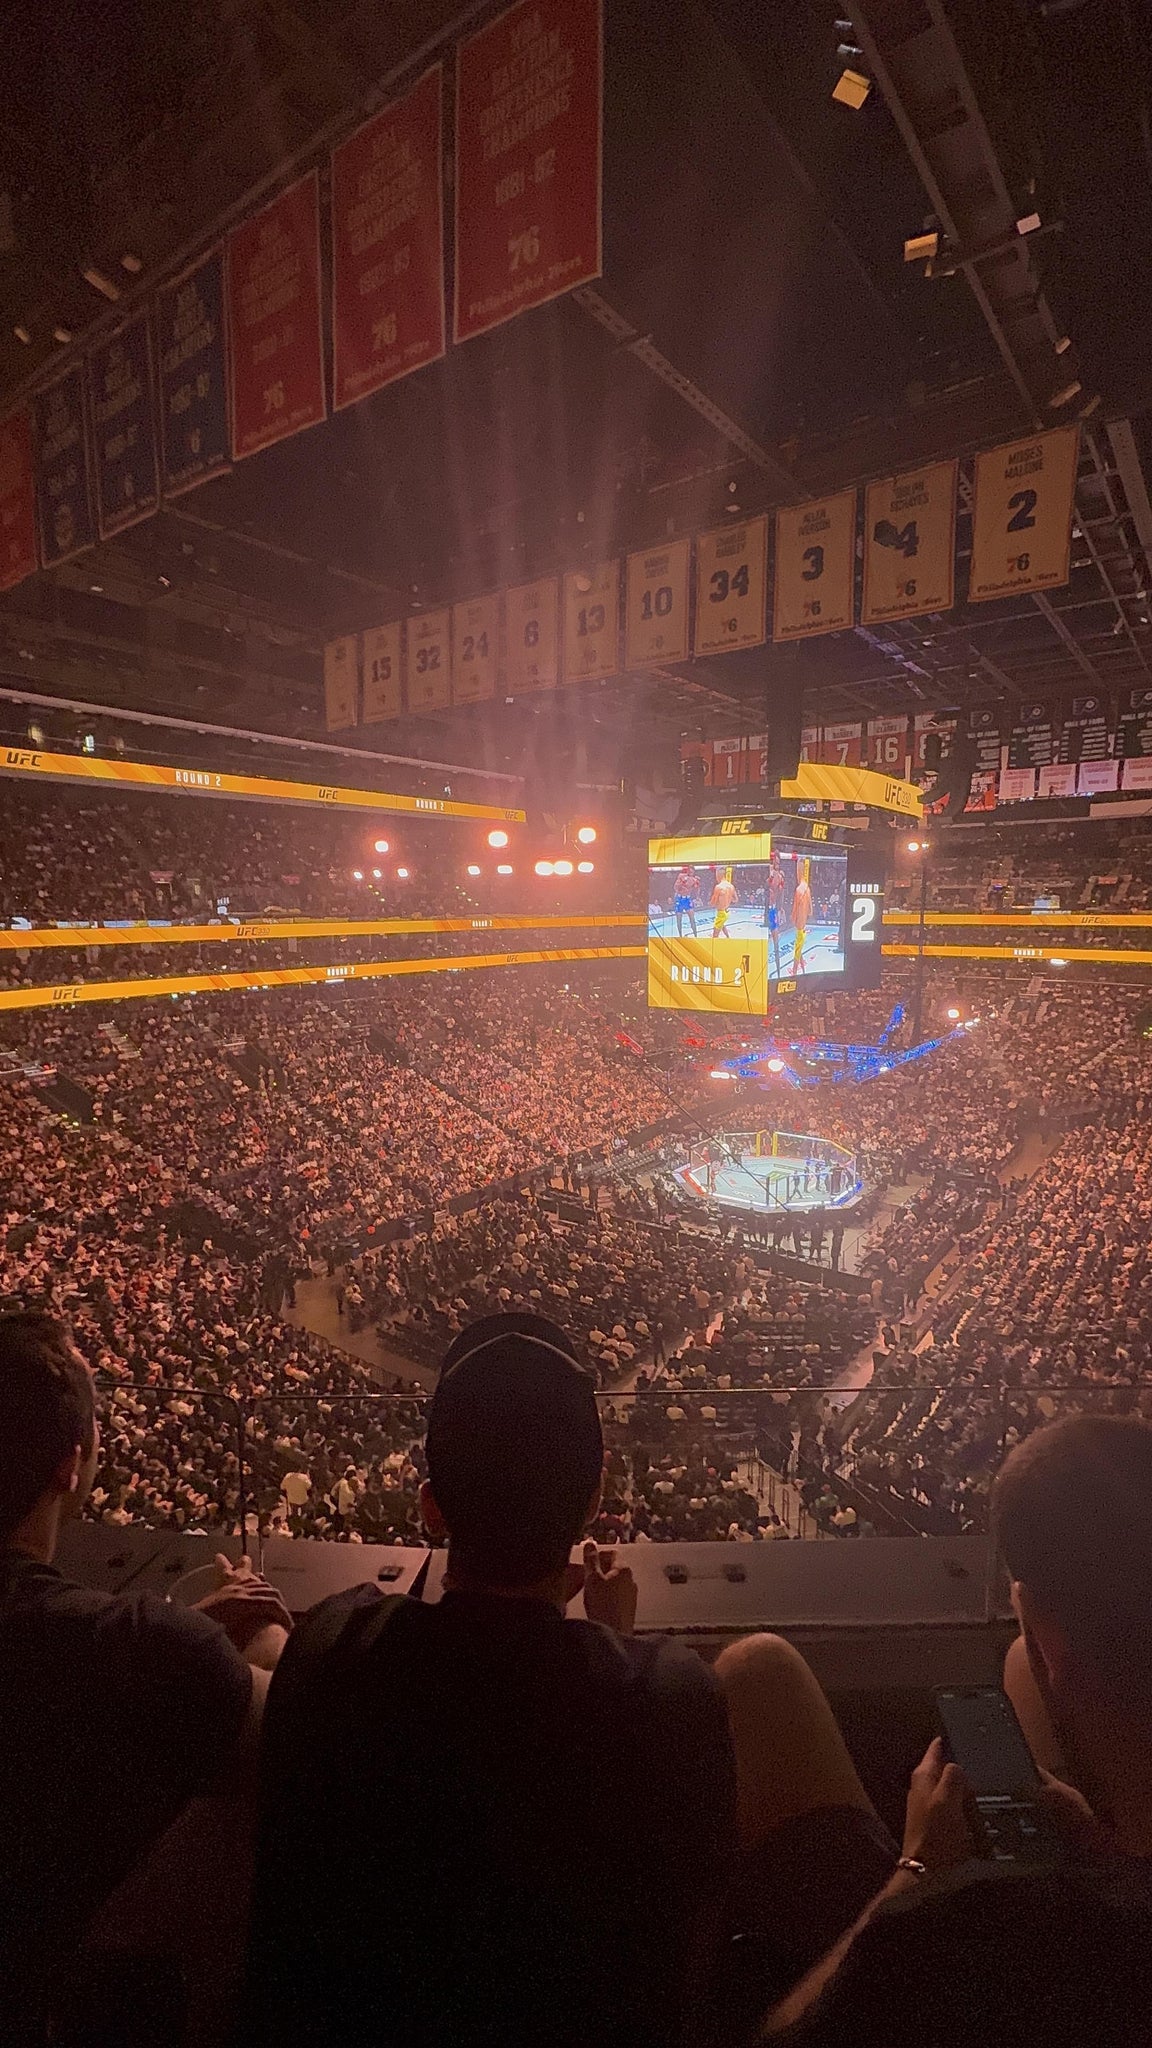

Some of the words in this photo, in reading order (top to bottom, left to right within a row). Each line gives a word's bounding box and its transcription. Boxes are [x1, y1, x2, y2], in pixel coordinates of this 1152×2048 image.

[1007, 489, 1037, 532] 2
[897, 520, 919, 558] 4
[801, 545, 824, 581] 3
[1007, 552, 1030, 573] 76
[709, 564, 750, 604] 34
[641, 586, 673, 621] 10
[577, 604, 605, 637] 13
[462, 631, 489, 661] 24
[524, 620, 539, 648] 6
[371, 656, 392, 683] 15
[416, 645, 441, 674] 32
[7, 751, 43, 767] UFC
[874, 736, 898, 764] 16
[175, 770, 210, 786] ROUND
[215, 775, 221, 787] 2
[726, 755, 734, 779] 1
[318, 789, 338, 800] UFC
[440, 801, 445, 811] 2
[885, 782, 902, 806] UFC
[721, 820, 751, 835] UFC
[811, 823, 828, 840] UFC
[850, 883, 880, 893] ROUND
[236, 926, 258, 936] UFC
[851, 898, 875, 941] 2
[1080, 916, 1101, 924] UFC
[670, 965, 724, 984] ROUND
[733, 967, 742, 986] 2
[52, 987, 83, 1001] UFC
